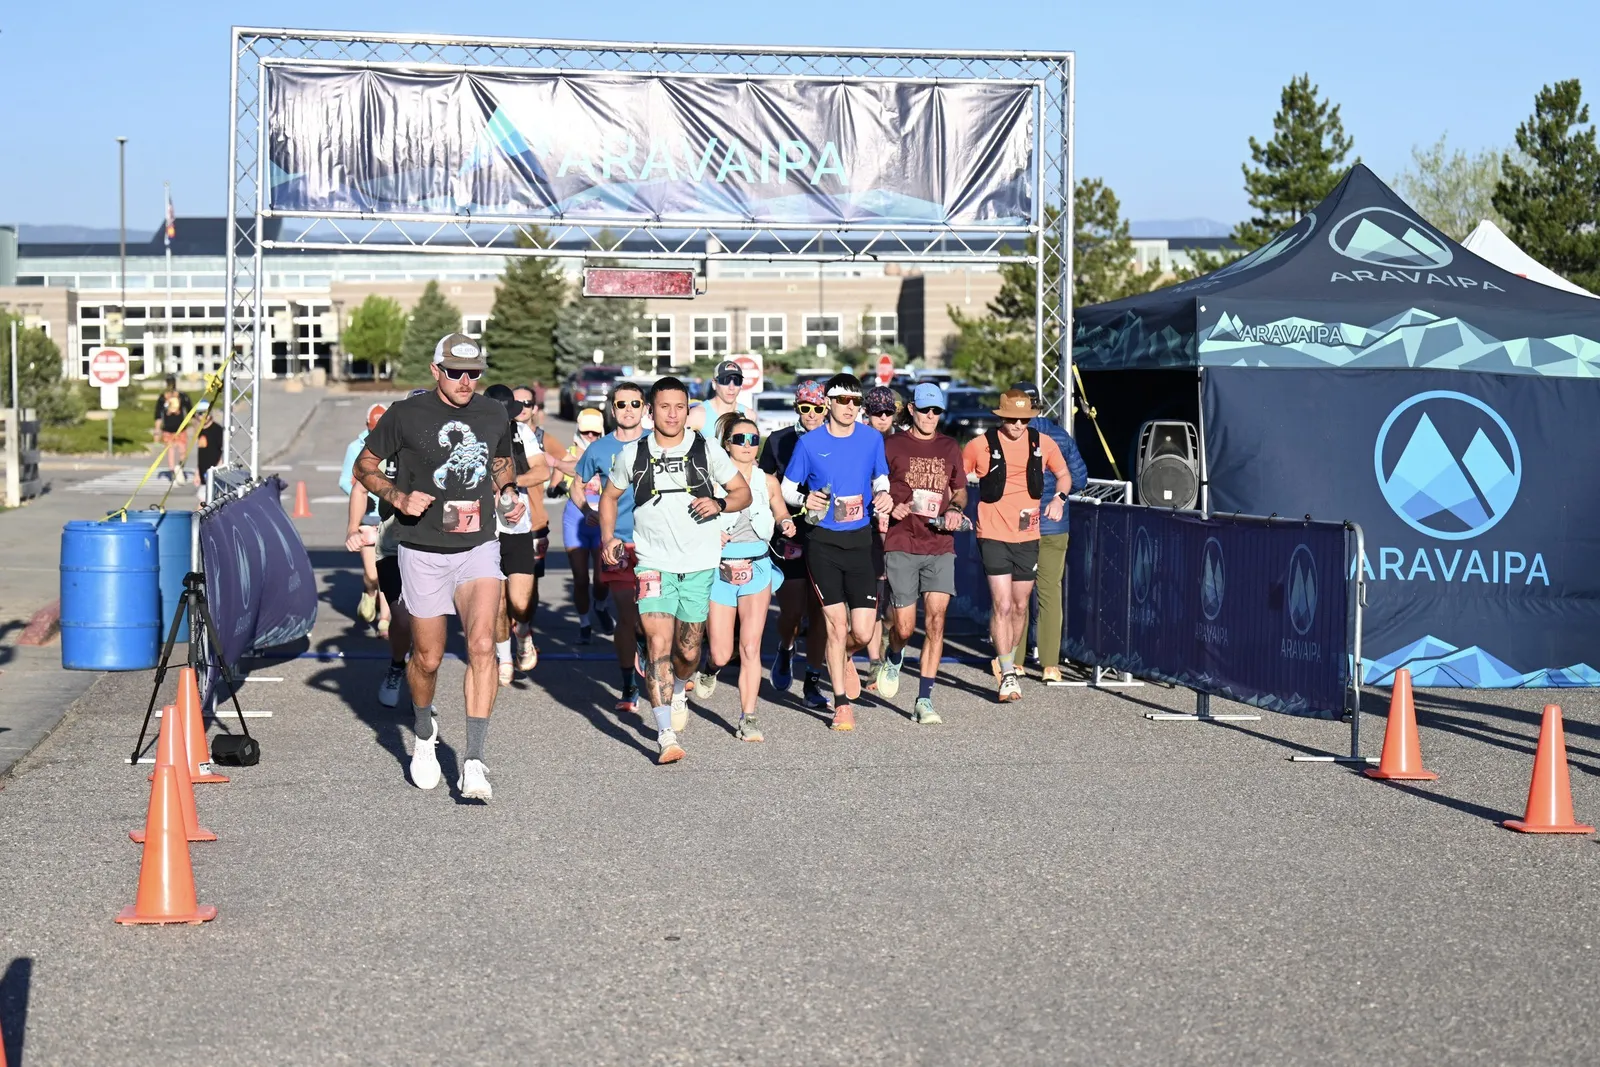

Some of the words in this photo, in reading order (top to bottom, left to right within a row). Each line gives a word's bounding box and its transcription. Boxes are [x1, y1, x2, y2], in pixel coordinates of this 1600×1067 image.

[556, 135, 849, 186] ARAVAIPA
[1330, 270, 1506, 293] ARAVAIPA
[1240, 324, 1343, 343] ARAVAIPA
[849, 506, 860, 516] 27
[927, 503, 937, 512] 13
[465, 515, 474, 526] 7
[1031, 516, 1039, 526] 25
[1345, 547, 1550, 586] ARAVAIPA
[734, 571, 748, 581] 29
[645, 582, 652, 592] 1
[1280, 638, 1322, 664] ARAVAIPA
